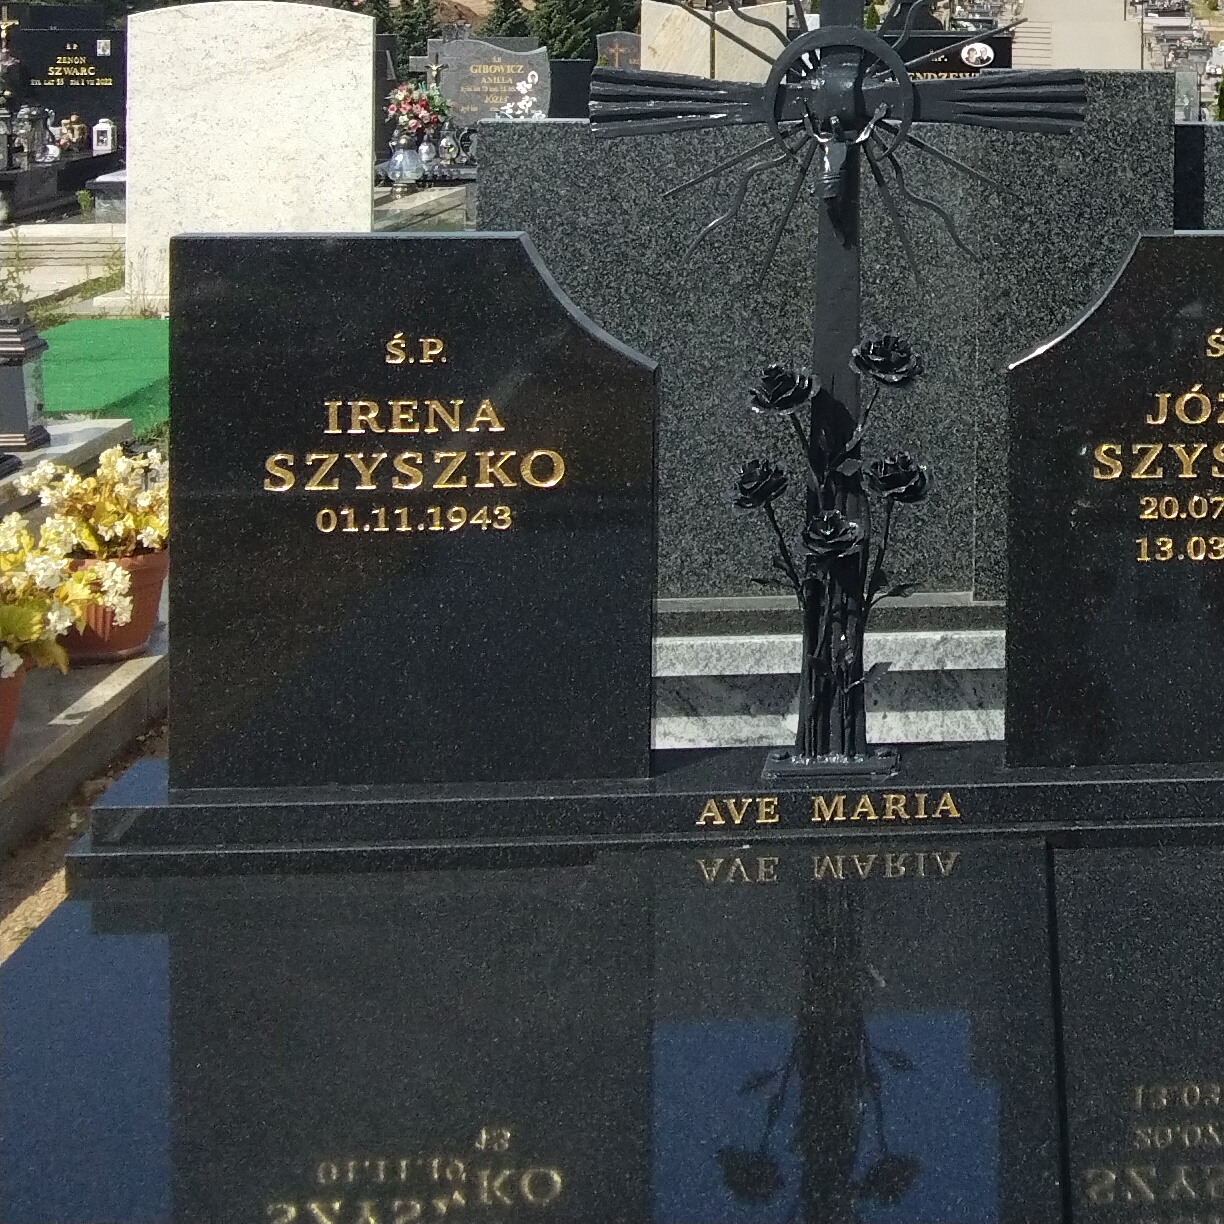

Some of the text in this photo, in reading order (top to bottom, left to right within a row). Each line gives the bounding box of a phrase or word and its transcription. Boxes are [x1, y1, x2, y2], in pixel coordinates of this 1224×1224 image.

[47, 66, 96, 76] SZWARC
[56, 56, 86, 64] ZENON
[469, 64, 524, 74] GIBOWICZ
[385, 332, 447, 364] Ś.P.
[323, 399, 506, 434] IRENA
[263, 449, 566, 492] SZYSZKO
[315, 505, 513, 533] 01.11.1943
[695, 792, 961, 826] AVE MARIA
